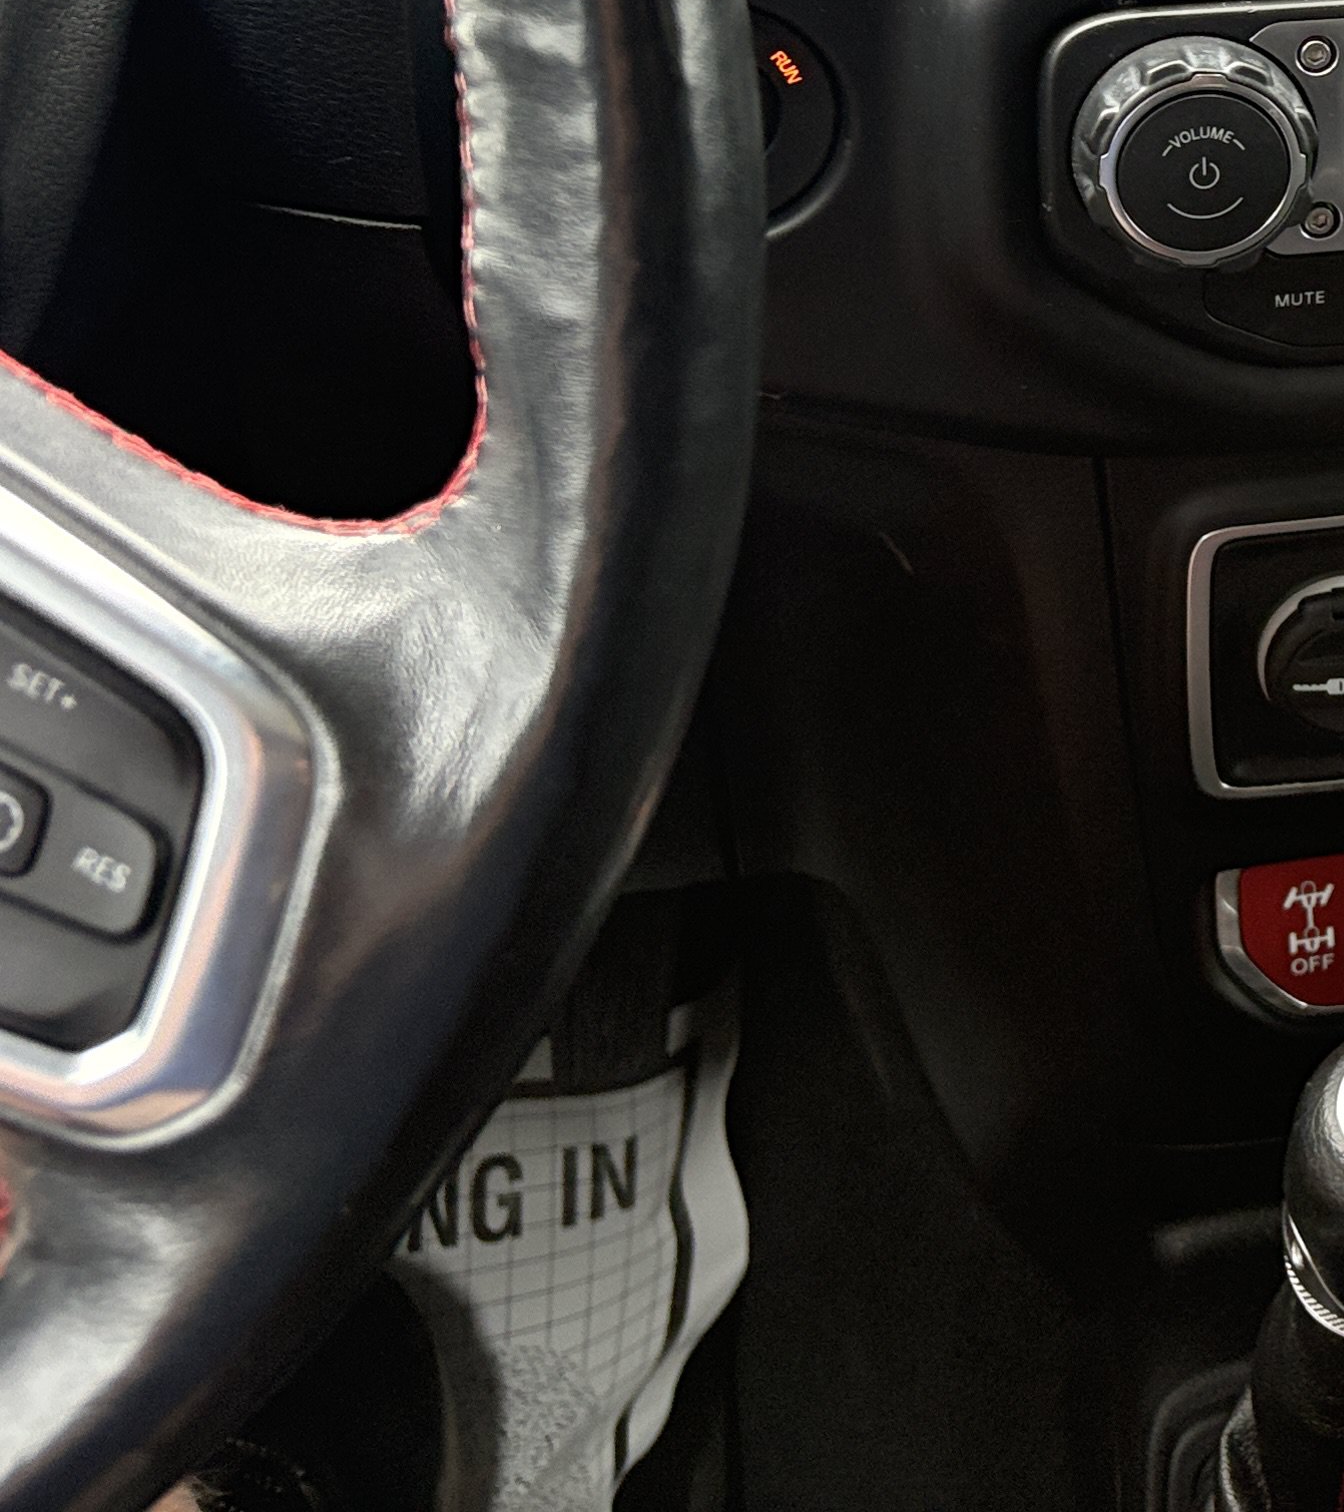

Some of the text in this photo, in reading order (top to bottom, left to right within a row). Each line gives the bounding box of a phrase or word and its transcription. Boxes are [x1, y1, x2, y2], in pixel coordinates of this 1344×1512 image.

[769, 51, 803, 85] RUN
[1168, 125, 1235, 148] VOLUME
[1274, 289, 1326, 308] MUTE
[72, 846, 131, 893] RES
[1290, 953, 1335, 977] OFF
[562, 1134, 638, 1228] IN
